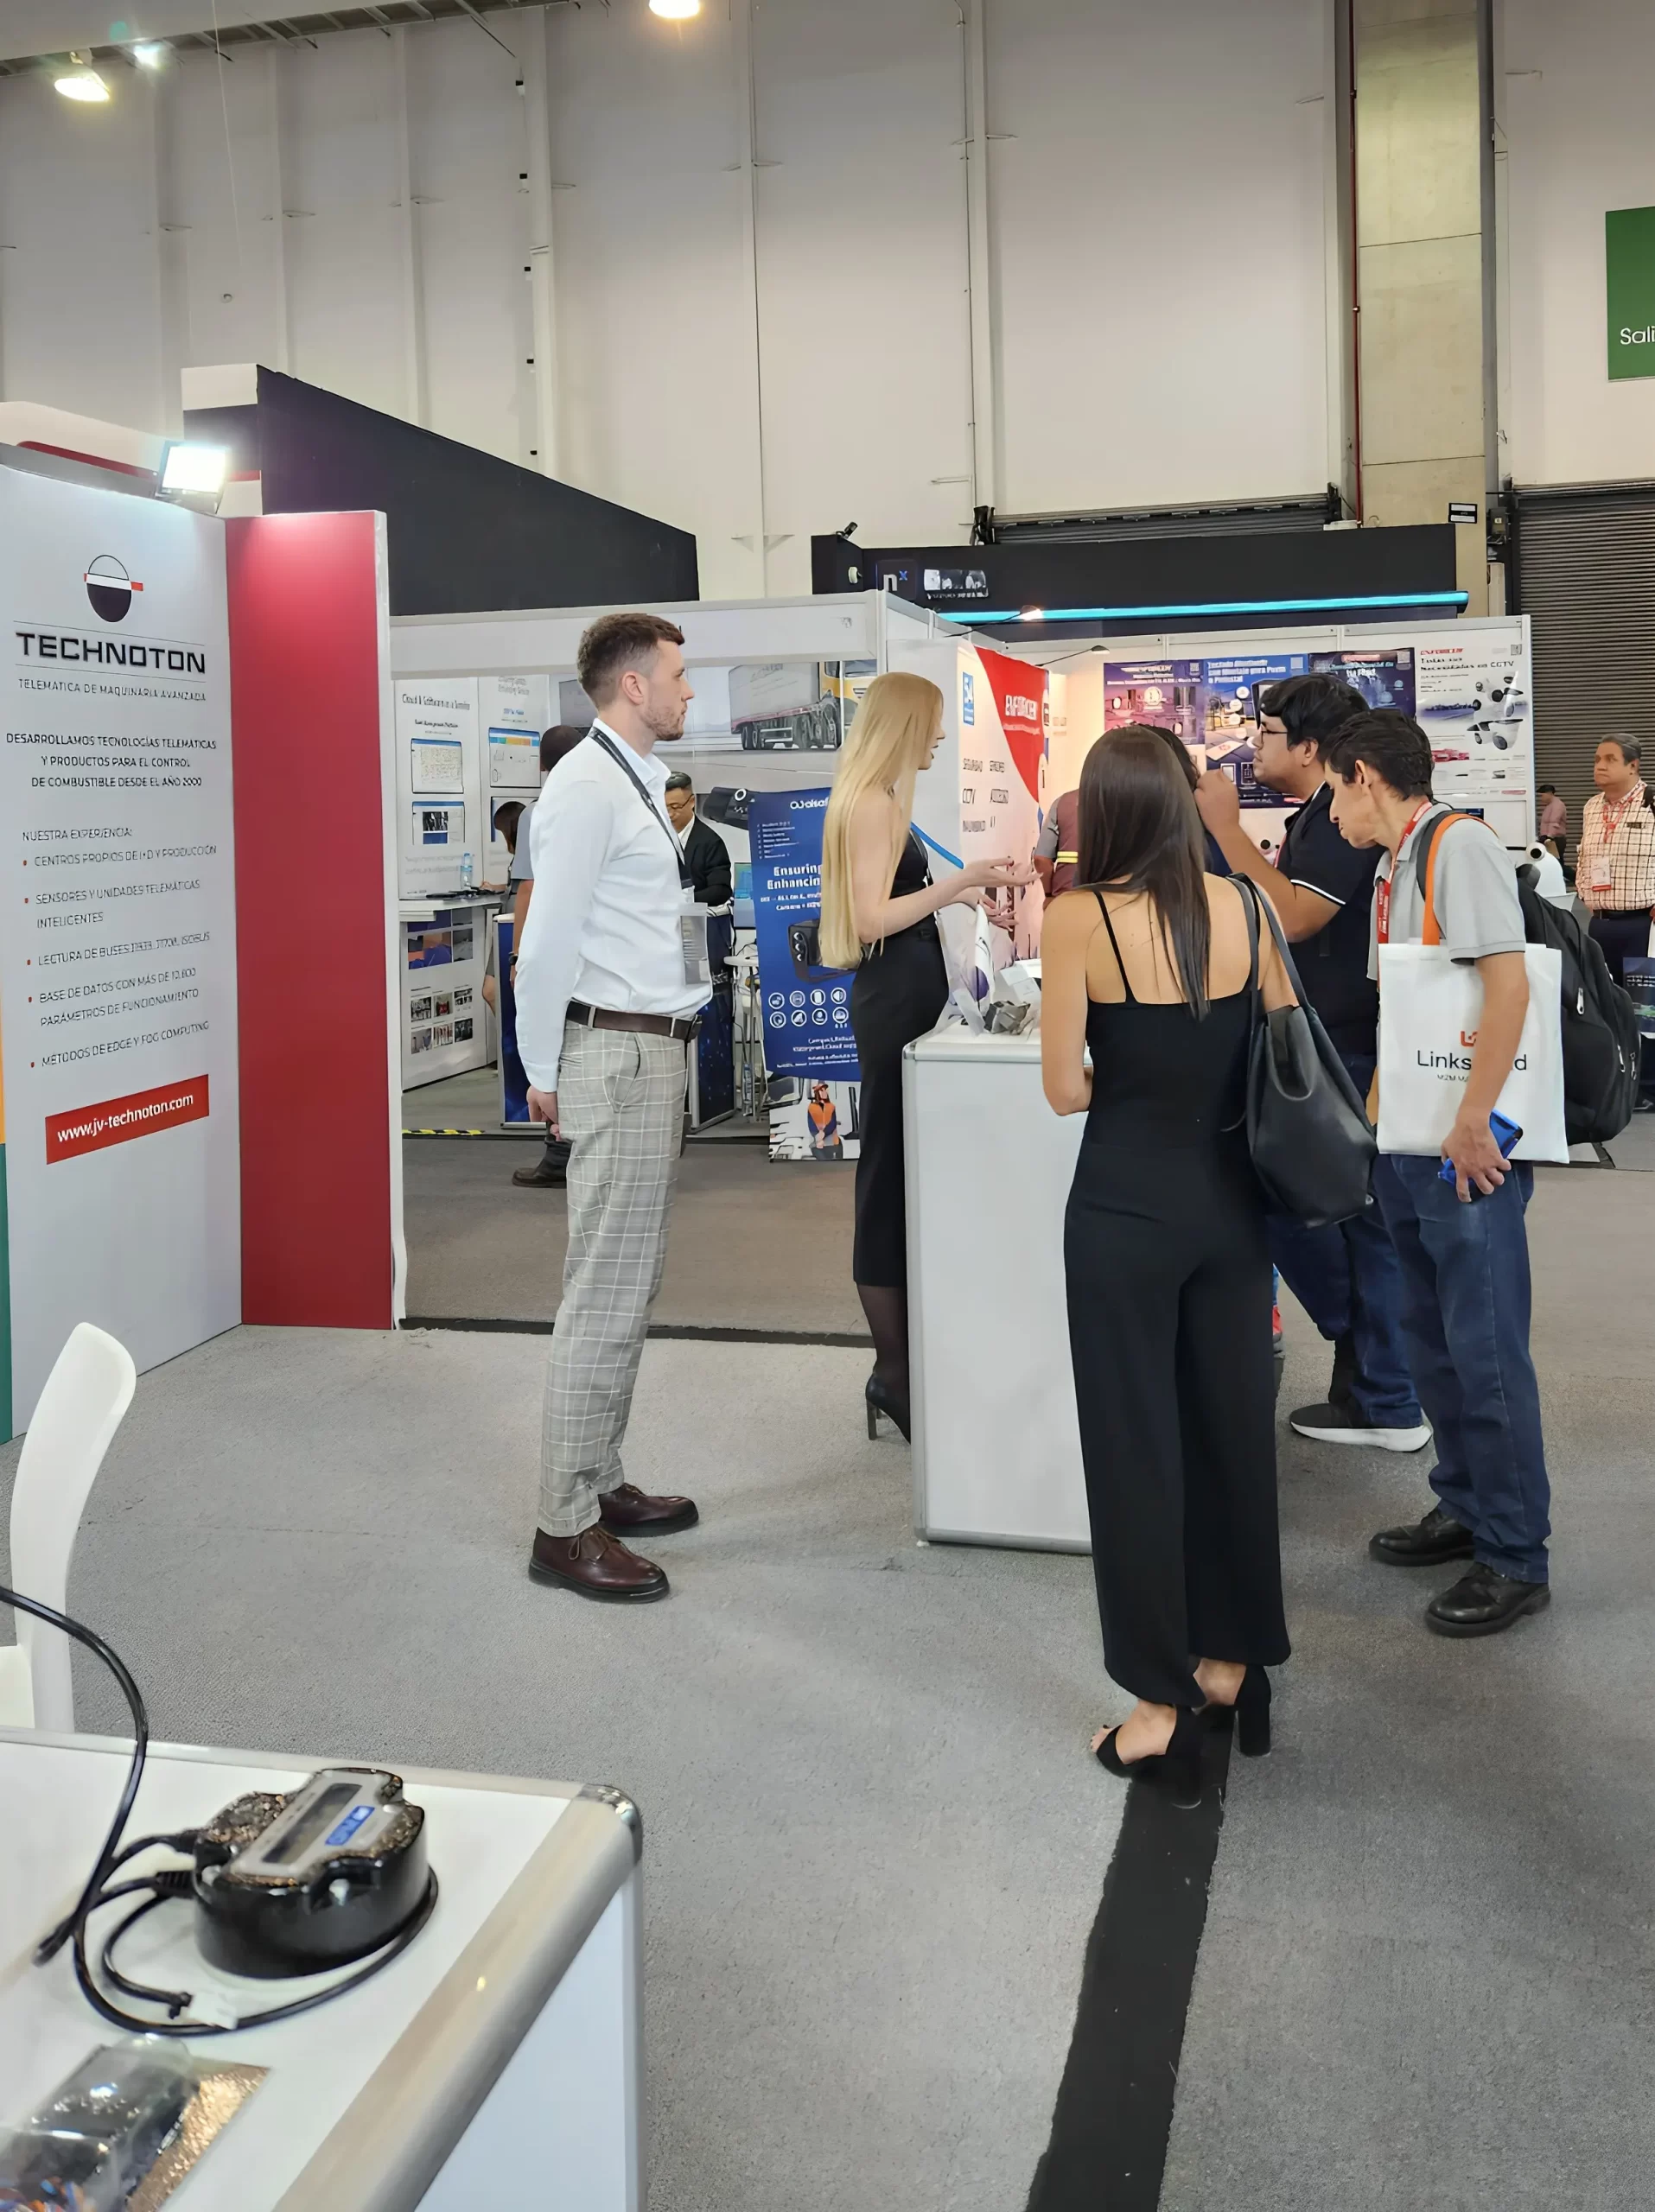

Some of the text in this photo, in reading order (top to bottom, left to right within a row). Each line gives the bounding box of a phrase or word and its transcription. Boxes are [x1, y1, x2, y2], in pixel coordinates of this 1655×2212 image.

[16, 632, 206, 674] TECHNOTON
[85, 684, 97, 694] DE
[100, 685, 158, 697] MAQUINARIA
[161, 690, 207, 701] AVANZADA
[6, 734, 95, 746] DESARROLLAMOS
[98, 735, 160, 747] TECNOLOGÍAS
[41, 756, 190, 767] Y PRODUCTOS PARA EL CONTROL
[32, 777, 45, 787] DE
[48, 777, 116, 787] COMBUSTIBLE
[118, 778, 148, 786] DESDE
[150, 778, 160, 786] EL
[162, 775, 181, 786] AÑO
[22, 830, 68, 842] NUESTRA
[35, 854, 80, 867] CENTROS
[82, 851, 124, 862] PROPIOS
[125, 850, 137, 861] DE
[767, 875, 820, 890] Enhancin
[35, 890, 86, 905] SENSORES
[89, 889, 94, 899] Y
[97, 885, 143, 899] UNIDADES
[37, 912, 104, 929] INTELIGENTES
[38, 950, 82, 965] LECTURA
[85, 948, 98, 959] DE
[99, 944, 130, 957] BUSES
[40, 989, 66, 1003] BASE
[67, 987, 80, 999] DE
[84, 982, 113, 995] DATOS
[116, 978, 136, 990] CON
[137, 973, 156, 987] MÁS
[158, 971, 169, 982] DE
[41, 988, 199, 1027] PARÁMETROS DE FUNCIONAMIENTO
[92, 1043, 105, 1056] DE
[107, 1038, 131, 1052] EDGE
[141, 1032, 159, 1046] FOG
[162, 1021, 210, 1040] COMPUTING
[57, 1095, 194, 1142] www.jv-technoton.com
